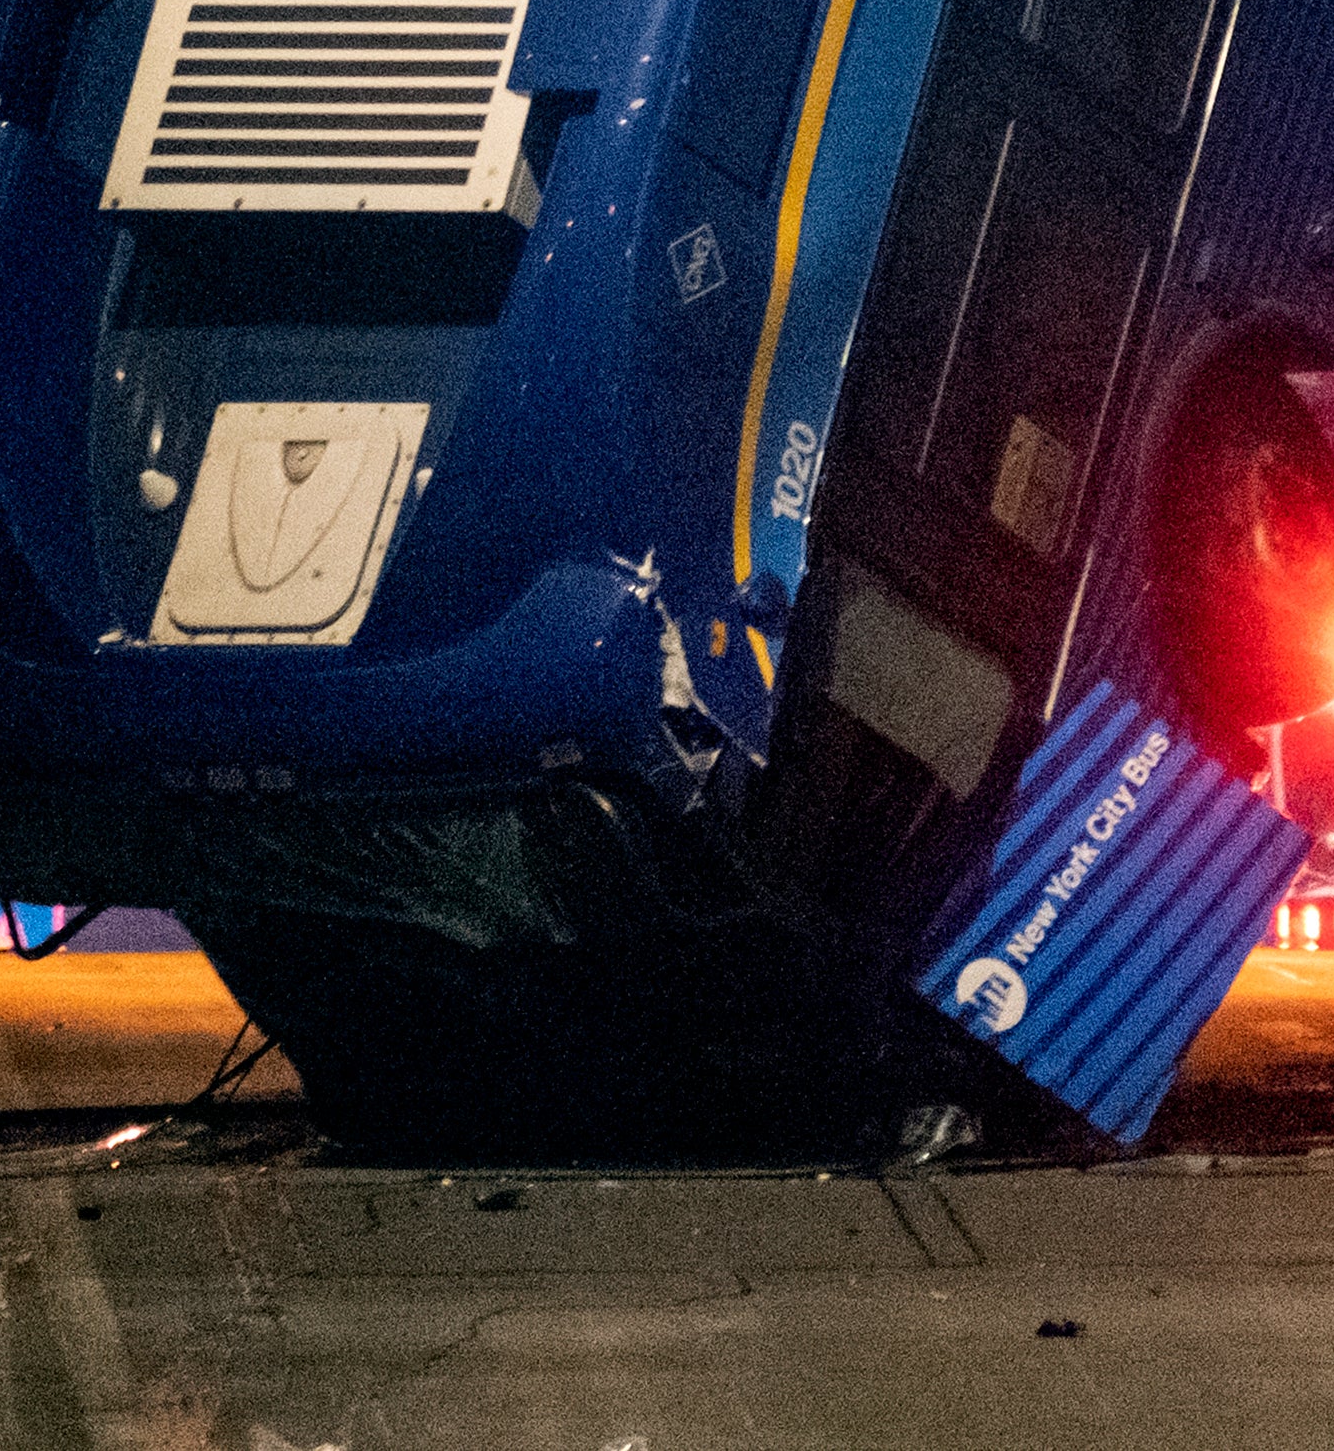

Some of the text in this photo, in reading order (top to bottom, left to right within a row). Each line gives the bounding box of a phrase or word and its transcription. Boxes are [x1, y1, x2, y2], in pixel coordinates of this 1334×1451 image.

[771, 421, 817, 520] 1020
[1007, 900, 1058, 965] New
[1046, 840, 1101, 901] York
[1086, 784, 1137, 842] City
[1121, 732, 1169, 787] Bus
